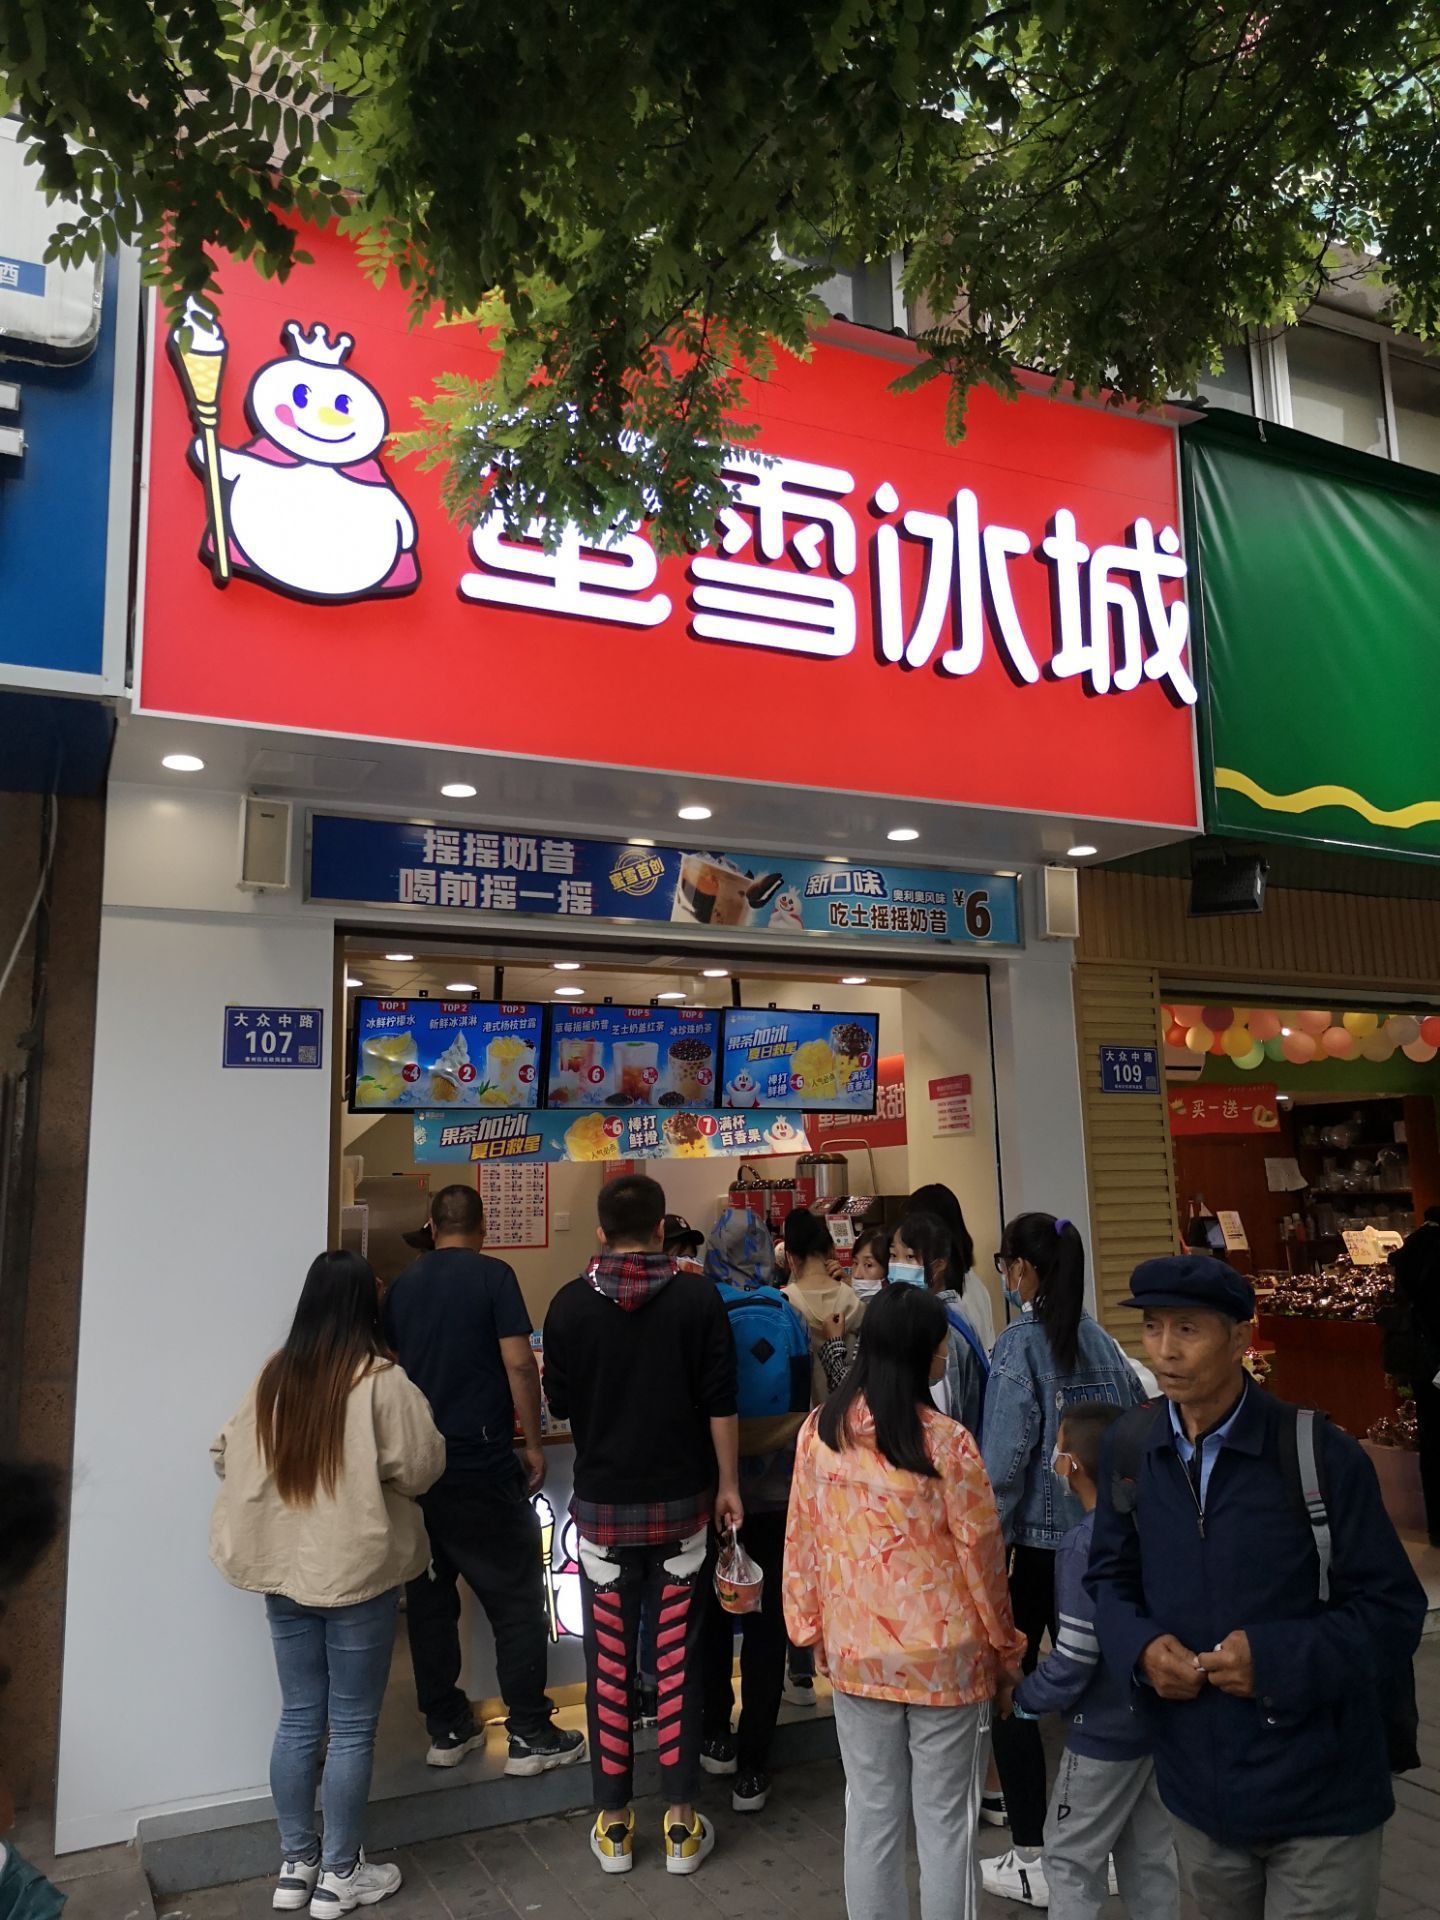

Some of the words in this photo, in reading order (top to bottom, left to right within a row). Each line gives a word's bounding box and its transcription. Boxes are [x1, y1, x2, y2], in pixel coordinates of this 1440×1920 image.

[423, 829, 575, 875] 摇摇奶昔
[609, 856, 666, 891] 蜜雪首创
[805, 869, 884, 896] 新口味
[399, 868, 592, 915] 喝前摇一摇
[893, 889, 947, 905] 奥利奥风味
[829, 902, 948, 934] 吃土摇摇奶昔
[381, 1002, 399, 1010] TOP
[442, 1003, 459, 1011] TOP
[502, 1005, 518, 1013] TOP
[628, 1009, 643, 1017] TOP
[233, 1013, 313, 1028] 大众中路
[366, 1015, 416, 1029] 冰鲜柠檬水
[429, 1015, 478, 1030] 新鲜冰淇淋
[245, 1031, 293, 1054] 107
[727, 1024, 788, 1049] 果茶加冰
[1105, 1051, 1153, 1063] 大众中路
[463, 1067, 472, 1080] 2
[1113, 1064, 1142, 1083] 109
[1191, 1100, 1253, 1119] 买一送一
[441, 1113, 529, 1146] 果茶加冰
[628, 1115, 656, 1132] 棒打
[703, 1118, 712, 1133] 7
[719, 1115, 745, 1132] 满杯
[628, 1131, 658, 1149] 鲜橙
[720, 1129, 762, 1147] 百香果
[470, 1134, 542, 1161] 夏日救星
